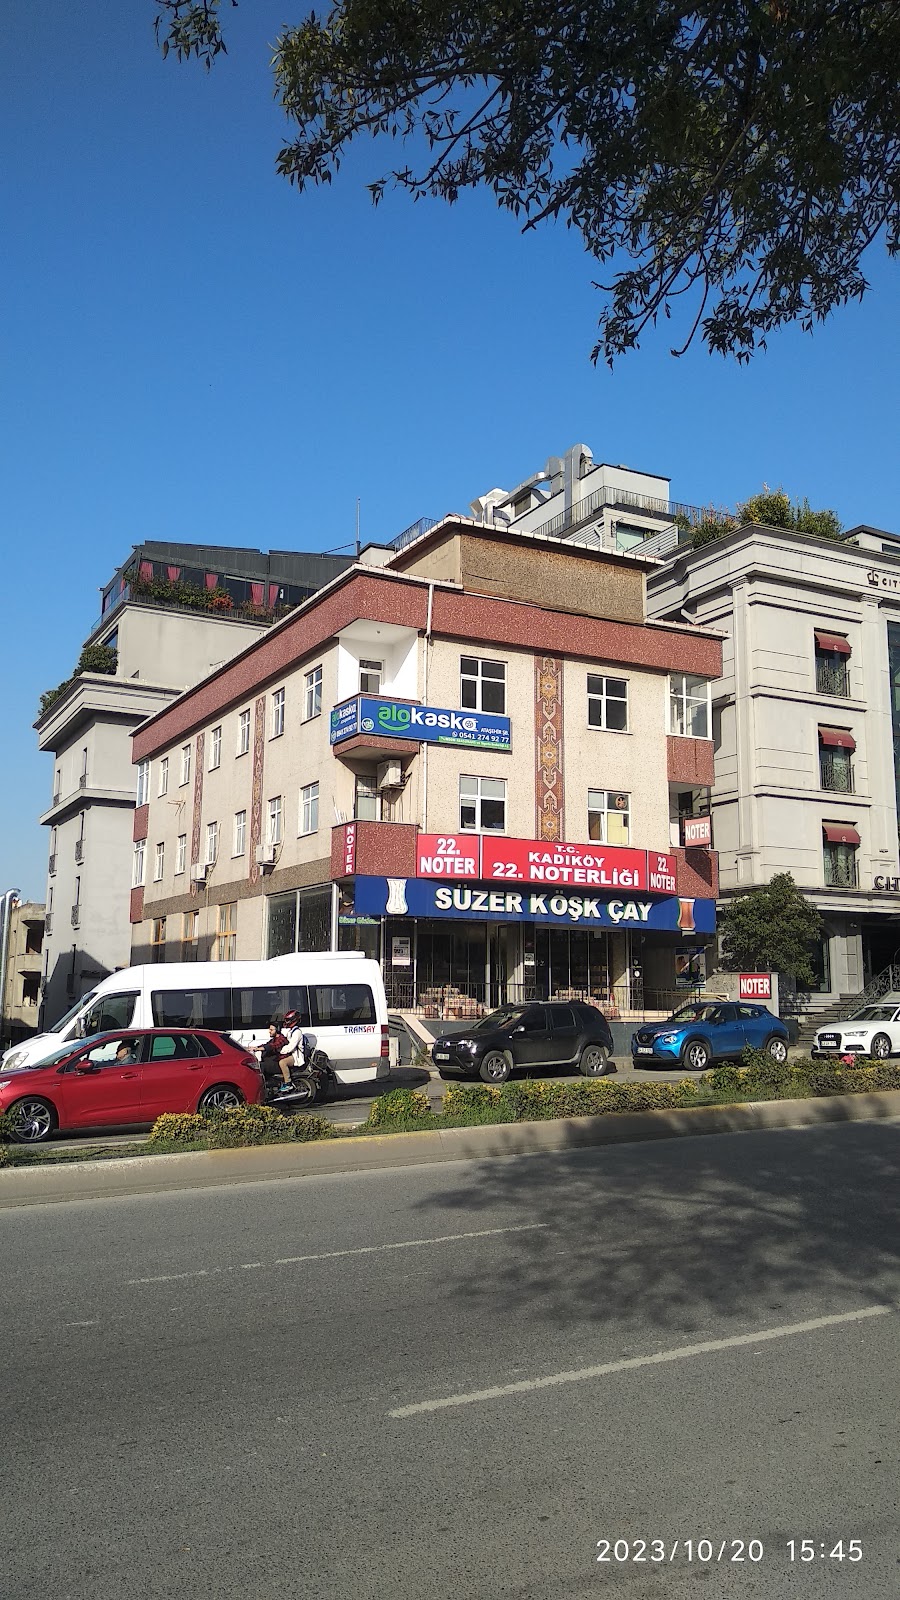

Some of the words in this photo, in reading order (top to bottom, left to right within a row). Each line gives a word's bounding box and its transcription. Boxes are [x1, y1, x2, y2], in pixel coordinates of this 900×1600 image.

[882, 577, 900, 588] CIT
[459, 731, 476, 740] 0541
[491, 735, 500, 743] 92
[501, 736, 510, 744] 77
[685, 822, 710, 841] NOTER
[345, 825, 355, 874] NOTER
[436, 837, 461, 855] 22.
[554, 844, 580, 854] T.C.
[420, 856, 476, 875] NOTER
[528, 851, 606, 868] KADIKÖY
[657, 856, 669, 872] 22.
[492, 862, 523, 879] 22.
[530, 864, 640, 887] NOTERLİĞİ
[650, 874, 677, 892] NOTER
[434, 884, 524, 914] SÜZER
[529, 889, 601, 921] KÖŞK
[606, 900, 653, 924] ÇAY
[740, 976, 771, 996] NOTER
[343, 1025, 376, 1034] TRANSAY
